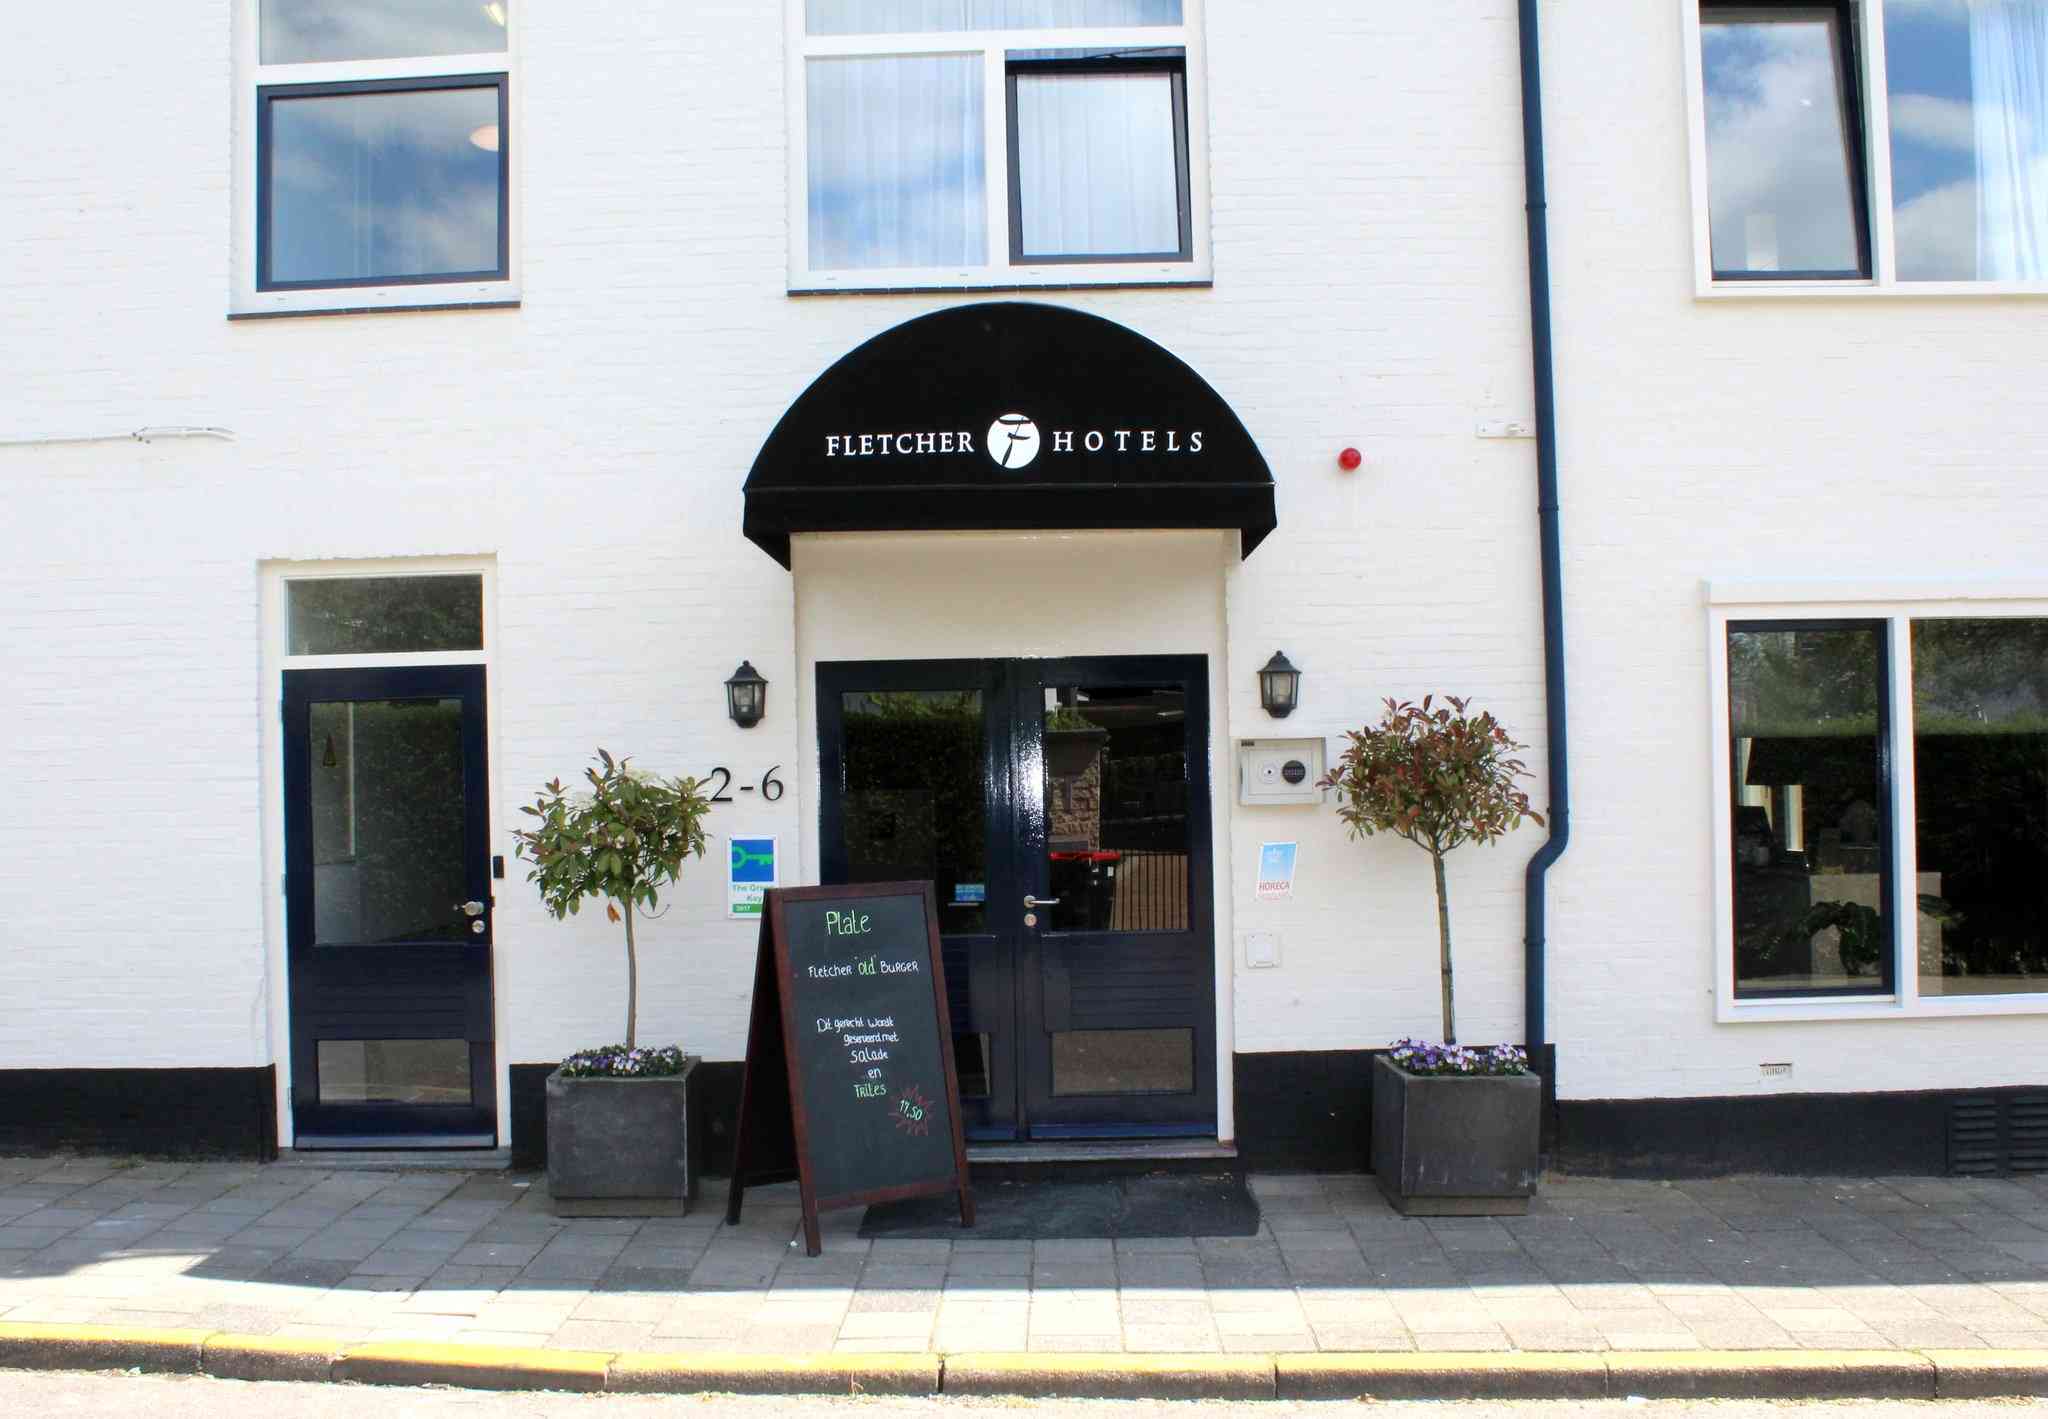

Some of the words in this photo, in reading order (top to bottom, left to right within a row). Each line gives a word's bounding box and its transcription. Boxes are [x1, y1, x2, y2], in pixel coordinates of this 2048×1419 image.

[825, 431, 975, 457] FLETCHER
[1052, 430, 1203, 453] HOTELS
[710, 764, 785, 803] 2-6
[1258, 880, 1290, 891] HORECA
[867, 1067, 882, 1079] en
